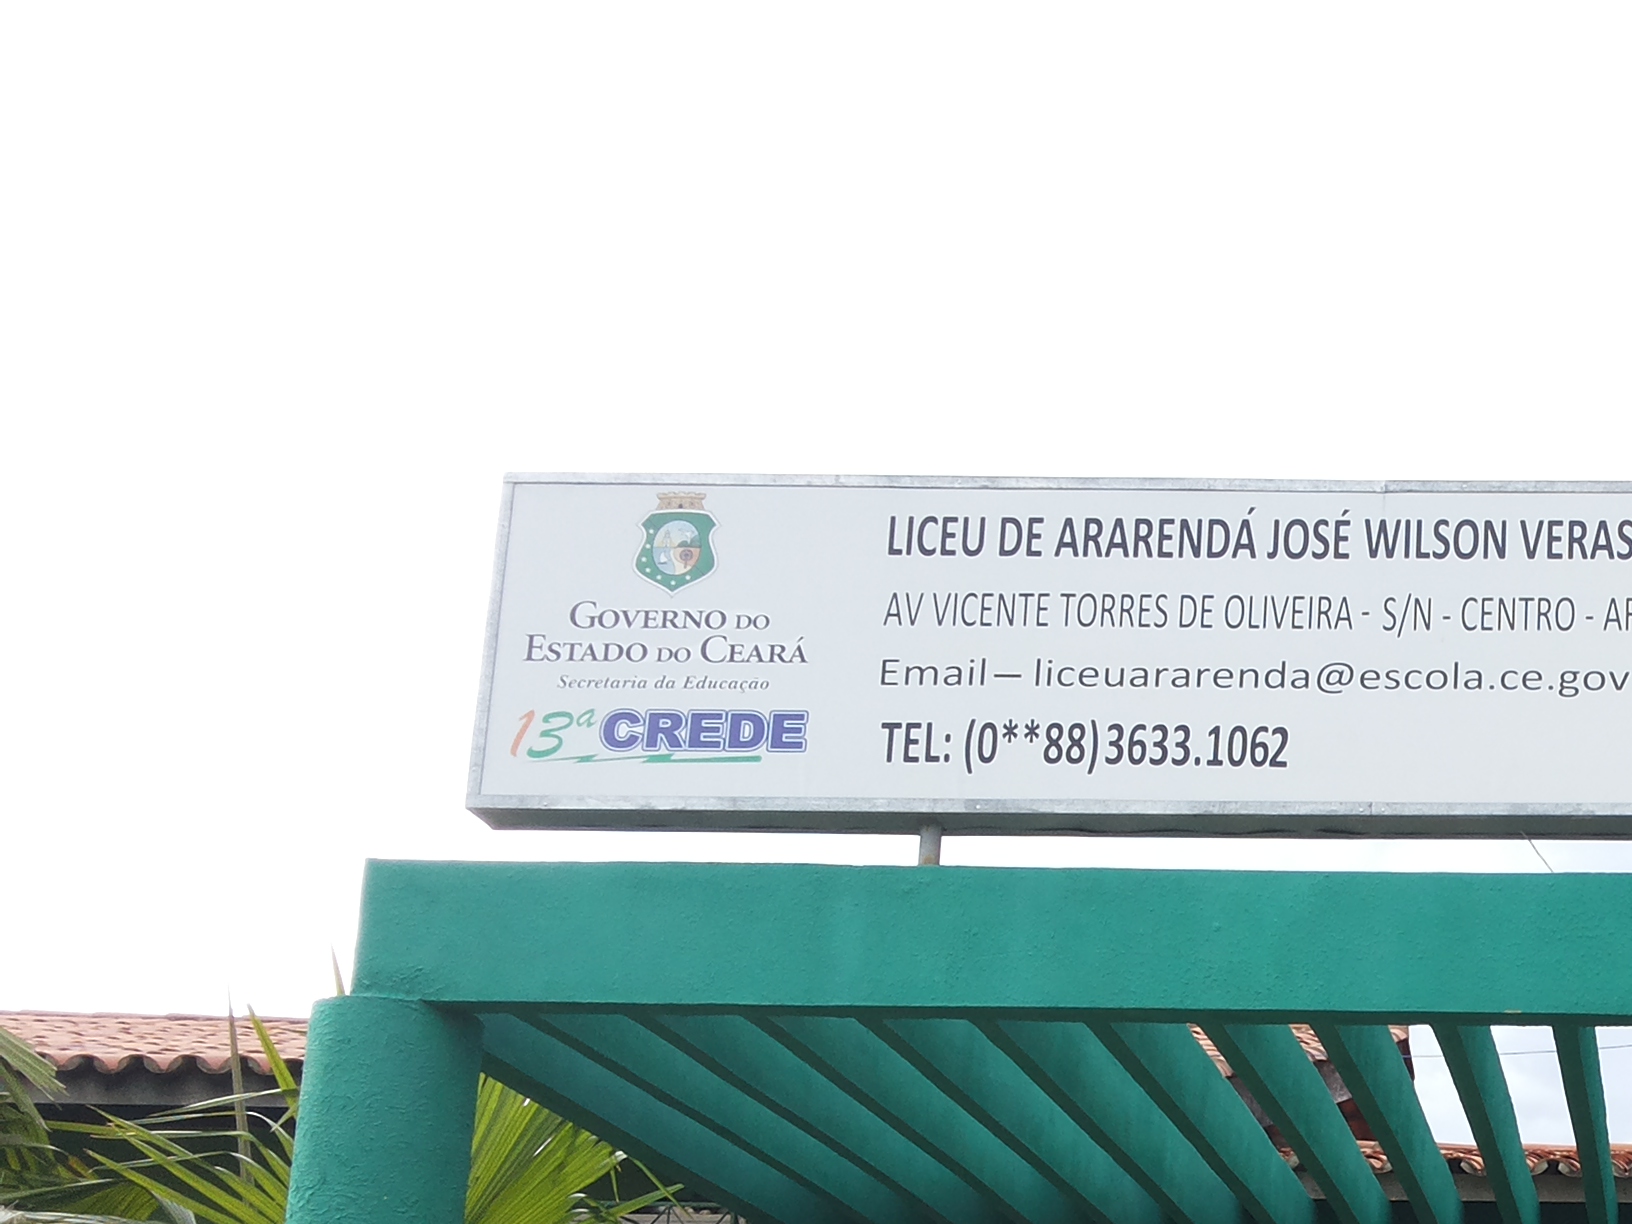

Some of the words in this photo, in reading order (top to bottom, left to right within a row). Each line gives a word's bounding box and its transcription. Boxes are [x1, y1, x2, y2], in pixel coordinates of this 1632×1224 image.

[887, 514, 987, 556] LICEU
[999, 516, 1044, 557] DE
[1054, 506, 1257, 559] ARARENDÁ
[1267, 509, 1351, 560] JOSÉ
[1364, 517, 1507, 560] WILSON
[883, 592, 924, 627] AV
[933, 592, 1051, 628] VICENTE
[1060, 592, 1169, 628] TORRES
[1179, 594, 1215, 629] DE
[1224, 594, 1353, 630] OLIVEIRA
[1382, 592, 1432, 638] S/N
[1460, 596, 1576, 631] CENTRO
[557, 674, 648, 690] Secretaria
[654, 675, 676, 690] da
[682, 675, 770, 693] Educação
[599, 708, 809, 752] CREDE
[881, 721, 952, 763] TEL:
